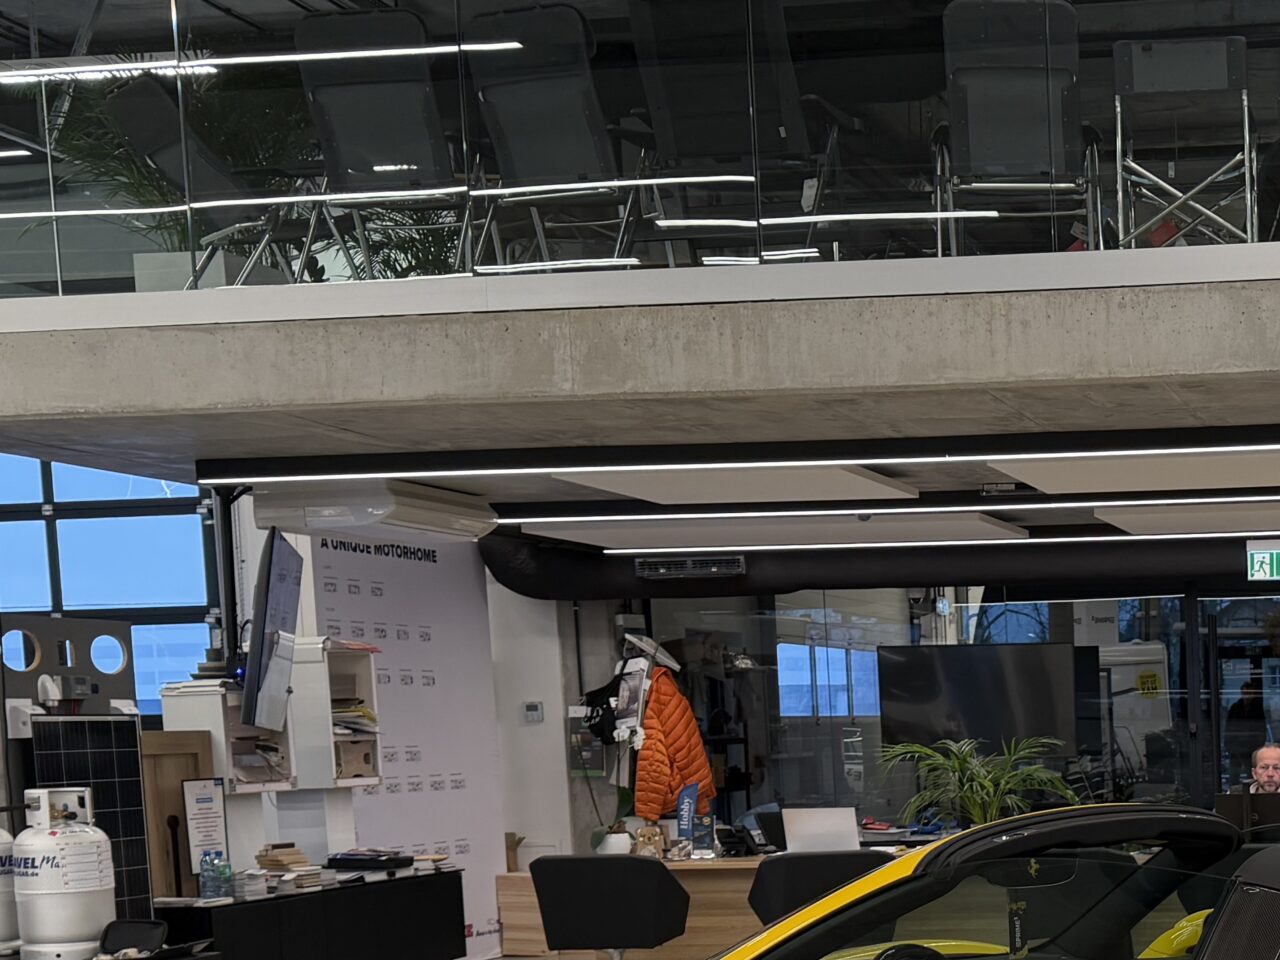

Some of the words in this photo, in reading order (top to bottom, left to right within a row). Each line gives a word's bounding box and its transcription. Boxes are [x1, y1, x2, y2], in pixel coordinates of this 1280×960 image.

[321, 538, 328, 549] A
[330, 539, 372, 555] UNIQUE
[374, 544, 437, 563] MOTORHOME
[680, 796, 692, 829] Hobby
